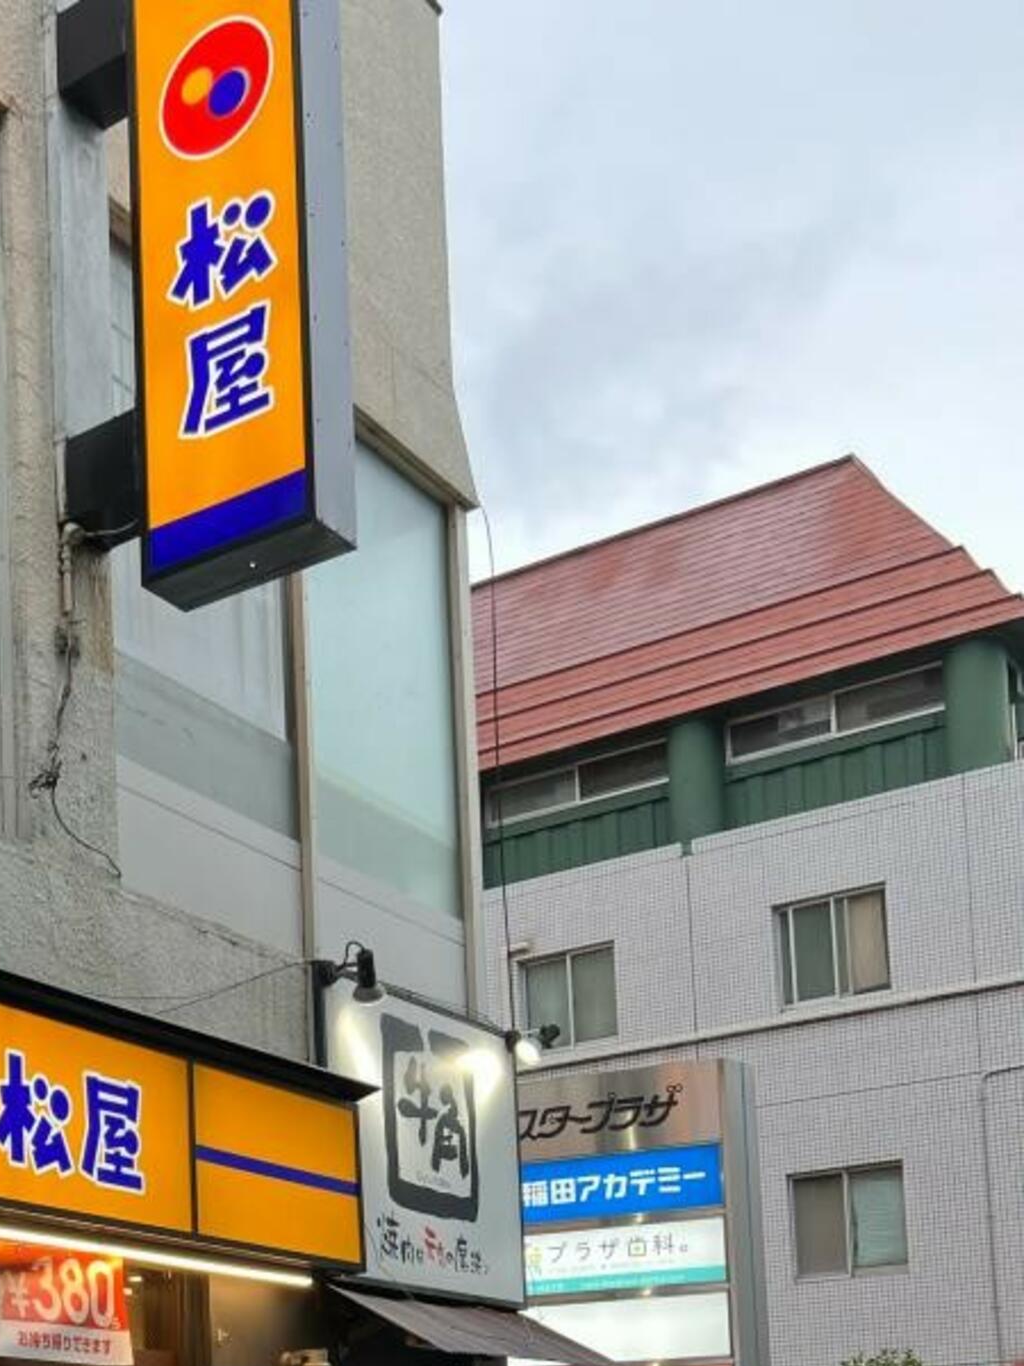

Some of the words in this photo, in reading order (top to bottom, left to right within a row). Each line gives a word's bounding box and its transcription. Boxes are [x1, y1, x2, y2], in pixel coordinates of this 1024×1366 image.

[167, 189, 277, 439] 松屋
[397, 1056, 469, 1178] 牛角
[519, 1084, 683, 1140] スタープラザ
